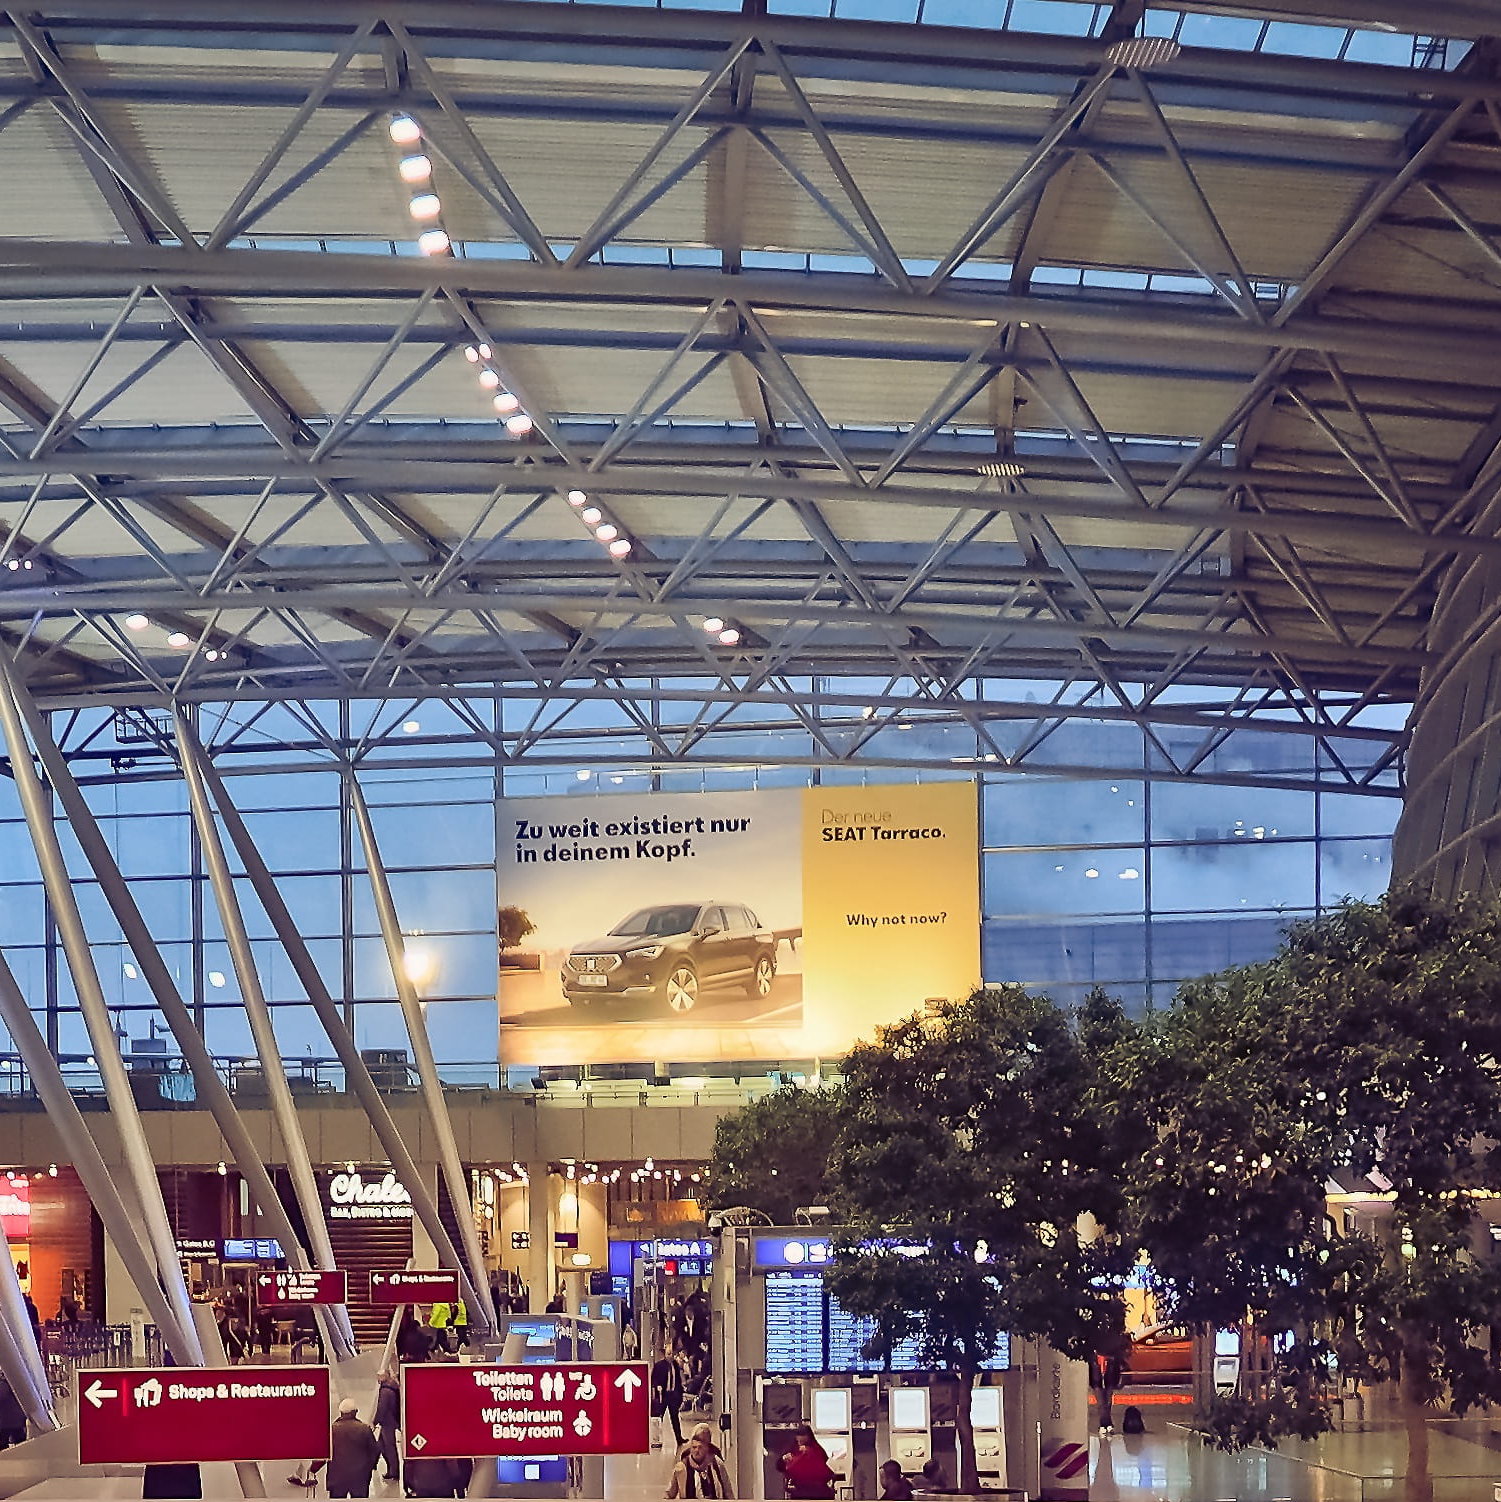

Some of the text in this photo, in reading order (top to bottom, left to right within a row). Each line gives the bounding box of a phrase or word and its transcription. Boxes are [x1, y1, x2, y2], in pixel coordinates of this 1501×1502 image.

[821, 809, 892, 824] Der neue
[515, 814, 751, 839] Zu weit existiert nur
[822, 827, 946, 841] SEAT Tarraco.
[515, 839, 695, 863] in deinem Kopf.
[846, 912, 947, 928] Why not now?
[473, 1371, 534, 1386] Toiletten
[168, 1383, 316, 1402] Shops & Restaurants
[490, 1387, 534, 1401] Toilets
[481, 1407, 563, 1423] Wickelraum
[492, 1423, 563, 1441] Baby room
